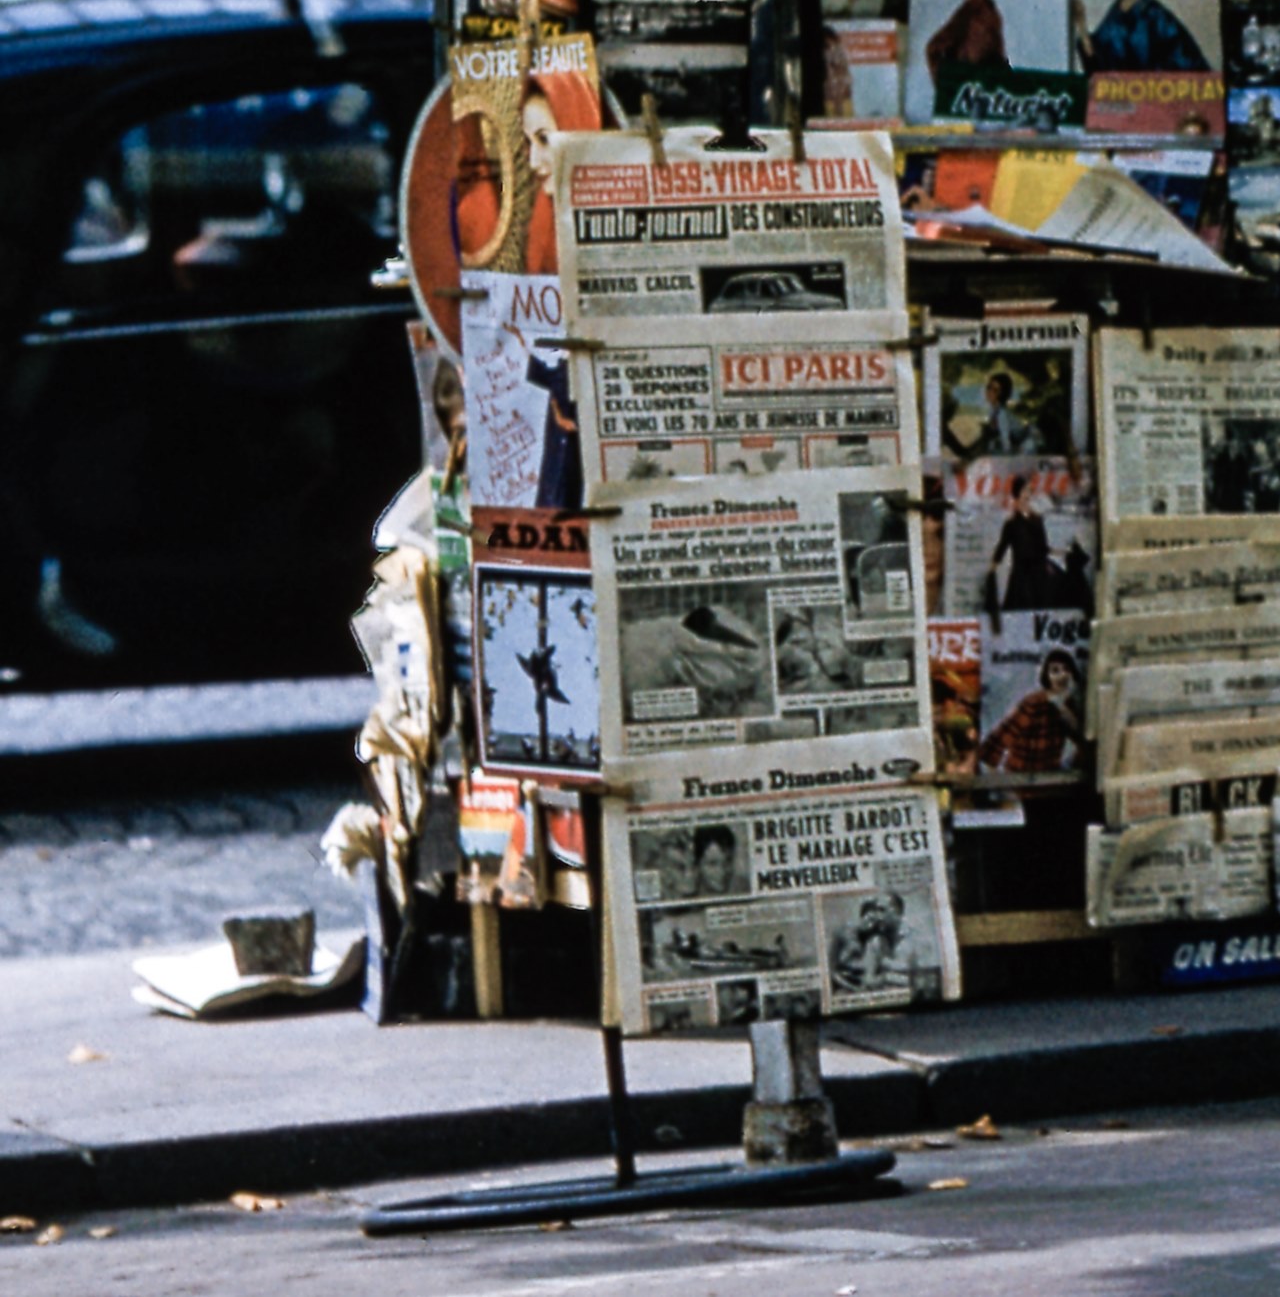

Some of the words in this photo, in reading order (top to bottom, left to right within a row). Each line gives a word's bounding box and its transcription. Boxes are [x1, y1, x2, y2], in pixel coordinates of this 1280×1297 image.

[454, 49, 520, 80] VOTRE
[711, 159, 801, 194] VIRAGE
[809, 157, 878, 191] TOTAL
[731, 206, 758, 231] DES
[763, 203, 884, 230] CONSTRUCTEURS
[578, 277, 638, 294] MAUVAIS
[646, 275, 695, 292] CALCUL
[625, 364, 709, 380] QUESTIONS
[722, 355, 771, 384] ICI
[784, 353, 886, 383] PARIS
[624, 416, 658, 432] VOICI
[664, 416, 685, 431] LES
[715, 413, 739, 429] ANS
[767, 411, 818, 428] JEUNESSE
[651, 502, 709, 519] France
[714, 497, 798, 514] Dimanche
[613, 545, 636, 562] Un
[641, 542, 688, 563] grand
[692, 538, 771, 560] chirurgien
[775, 536, 795, 551] du
[671, 564, 700, 578] une
[710, 559, 771, 578] cigogne
[1183, 679, 1213, 695] THE
[683, 776, 764, 798] France
[768, 762, 877, 791] Dimanche
[753, 818, 833, 841] BRIGITTE
[846, 805, 912, 832] BARDOT
[798, 835, 873, 861] MARIAGE
[884, 829, 930, 853] C'EST
[757, 863, 859, 890] MERVEILLEUX
[1173, 940, 1217, 970] ON
